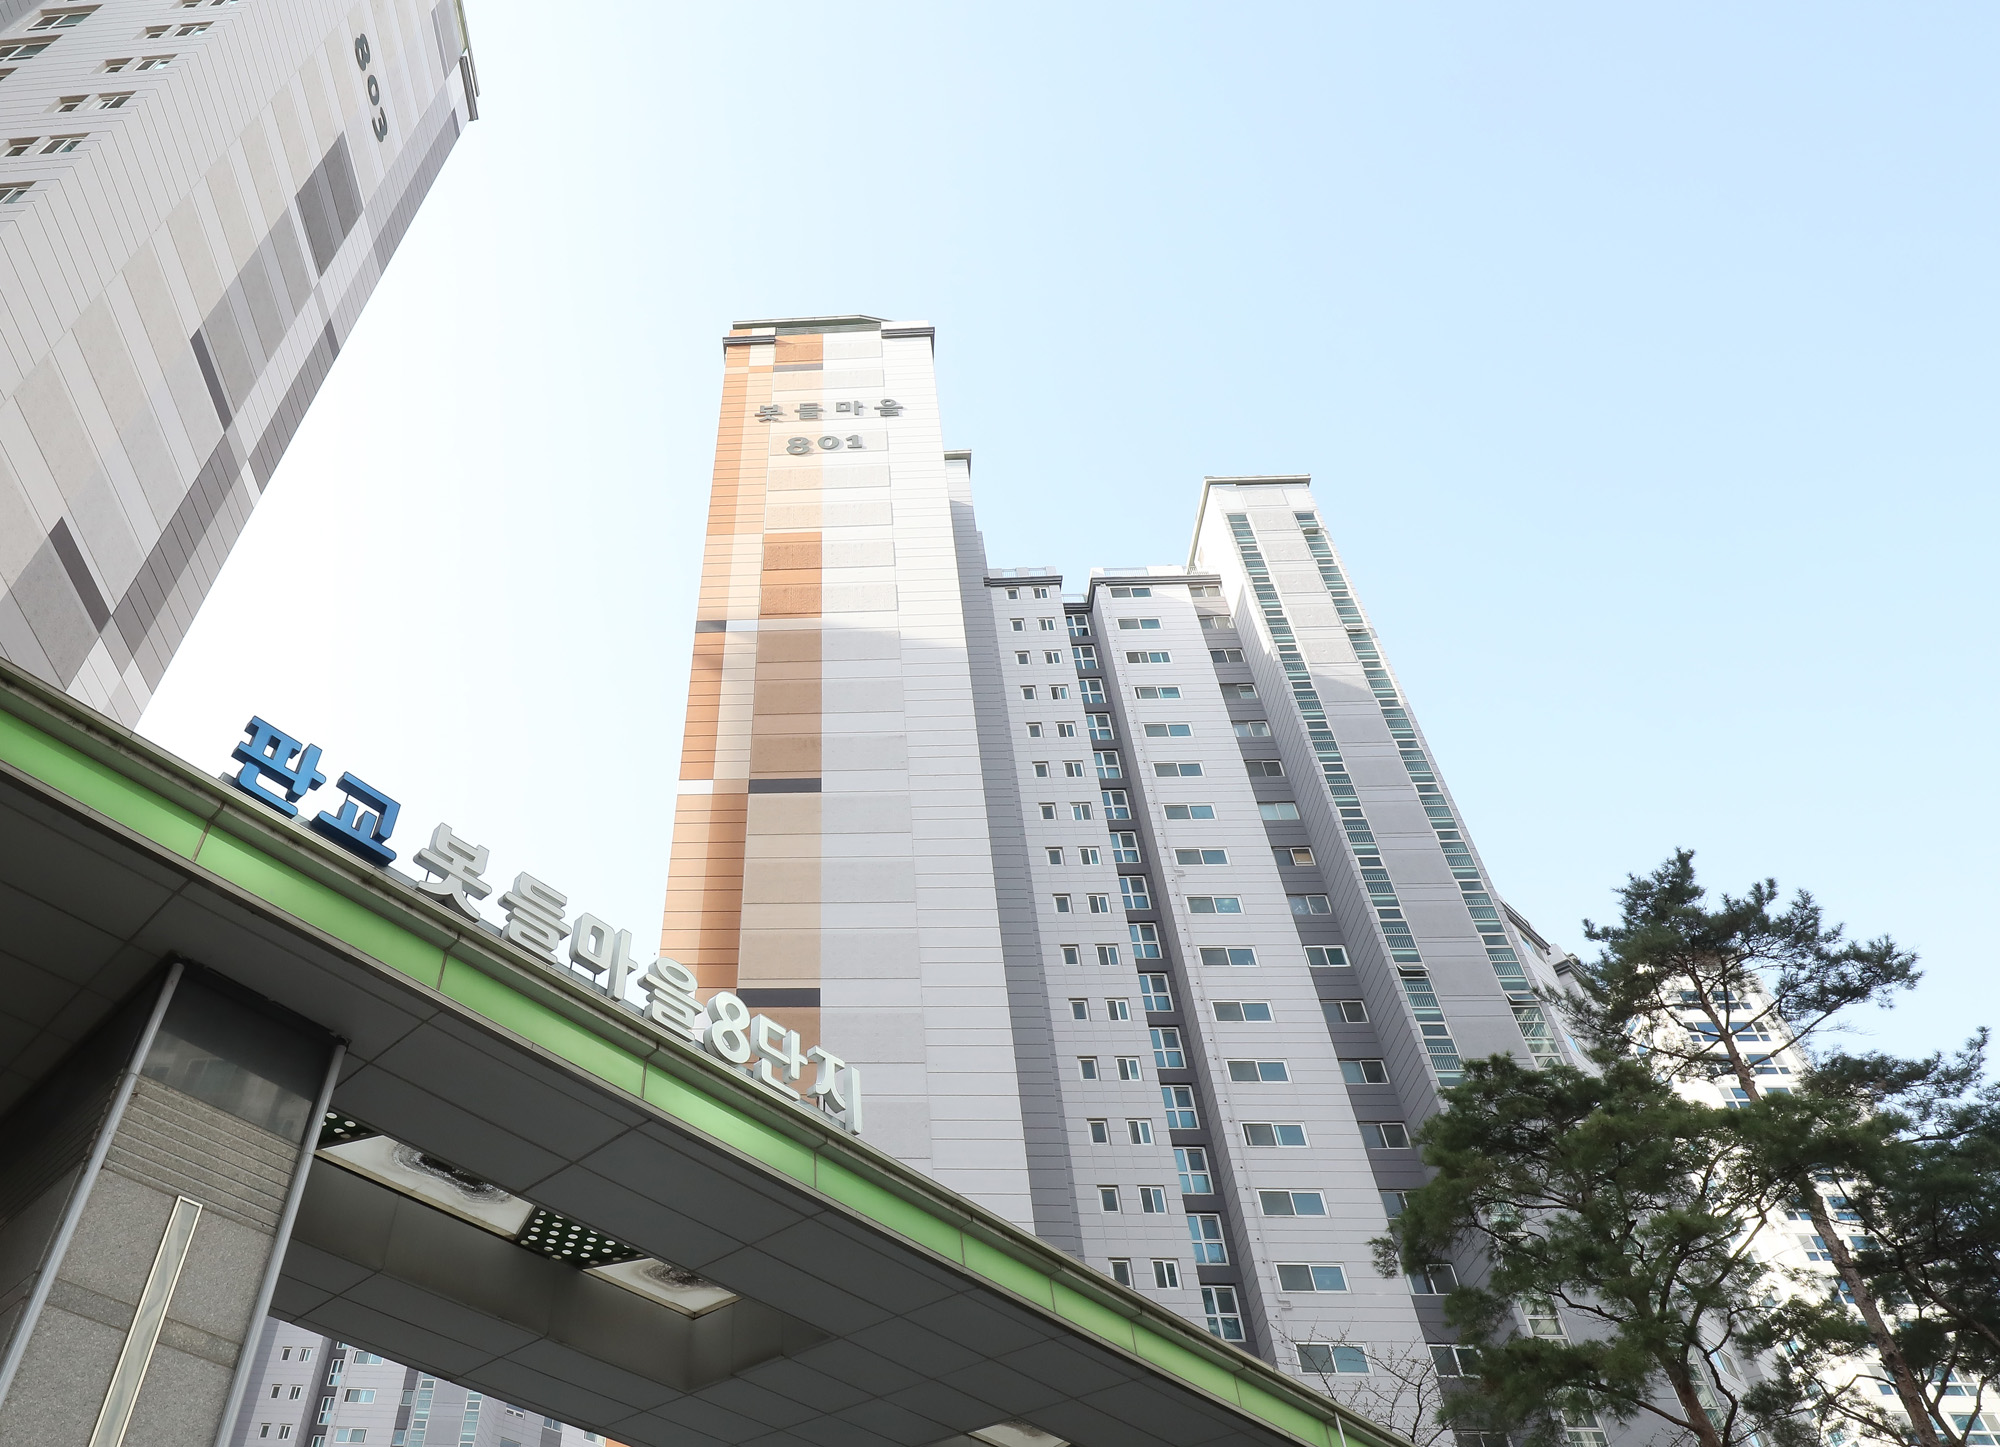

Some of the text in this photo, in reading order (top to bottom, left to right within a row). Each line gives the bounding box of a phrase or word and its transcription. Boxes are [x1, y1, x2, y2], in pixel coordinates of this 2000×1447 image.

[354, 33, 388, 143] 803
[754, 398, 904, 423] 봇들마을
[786, 434, 863, 455] 801
[231, 715, 402, 867] 판교
